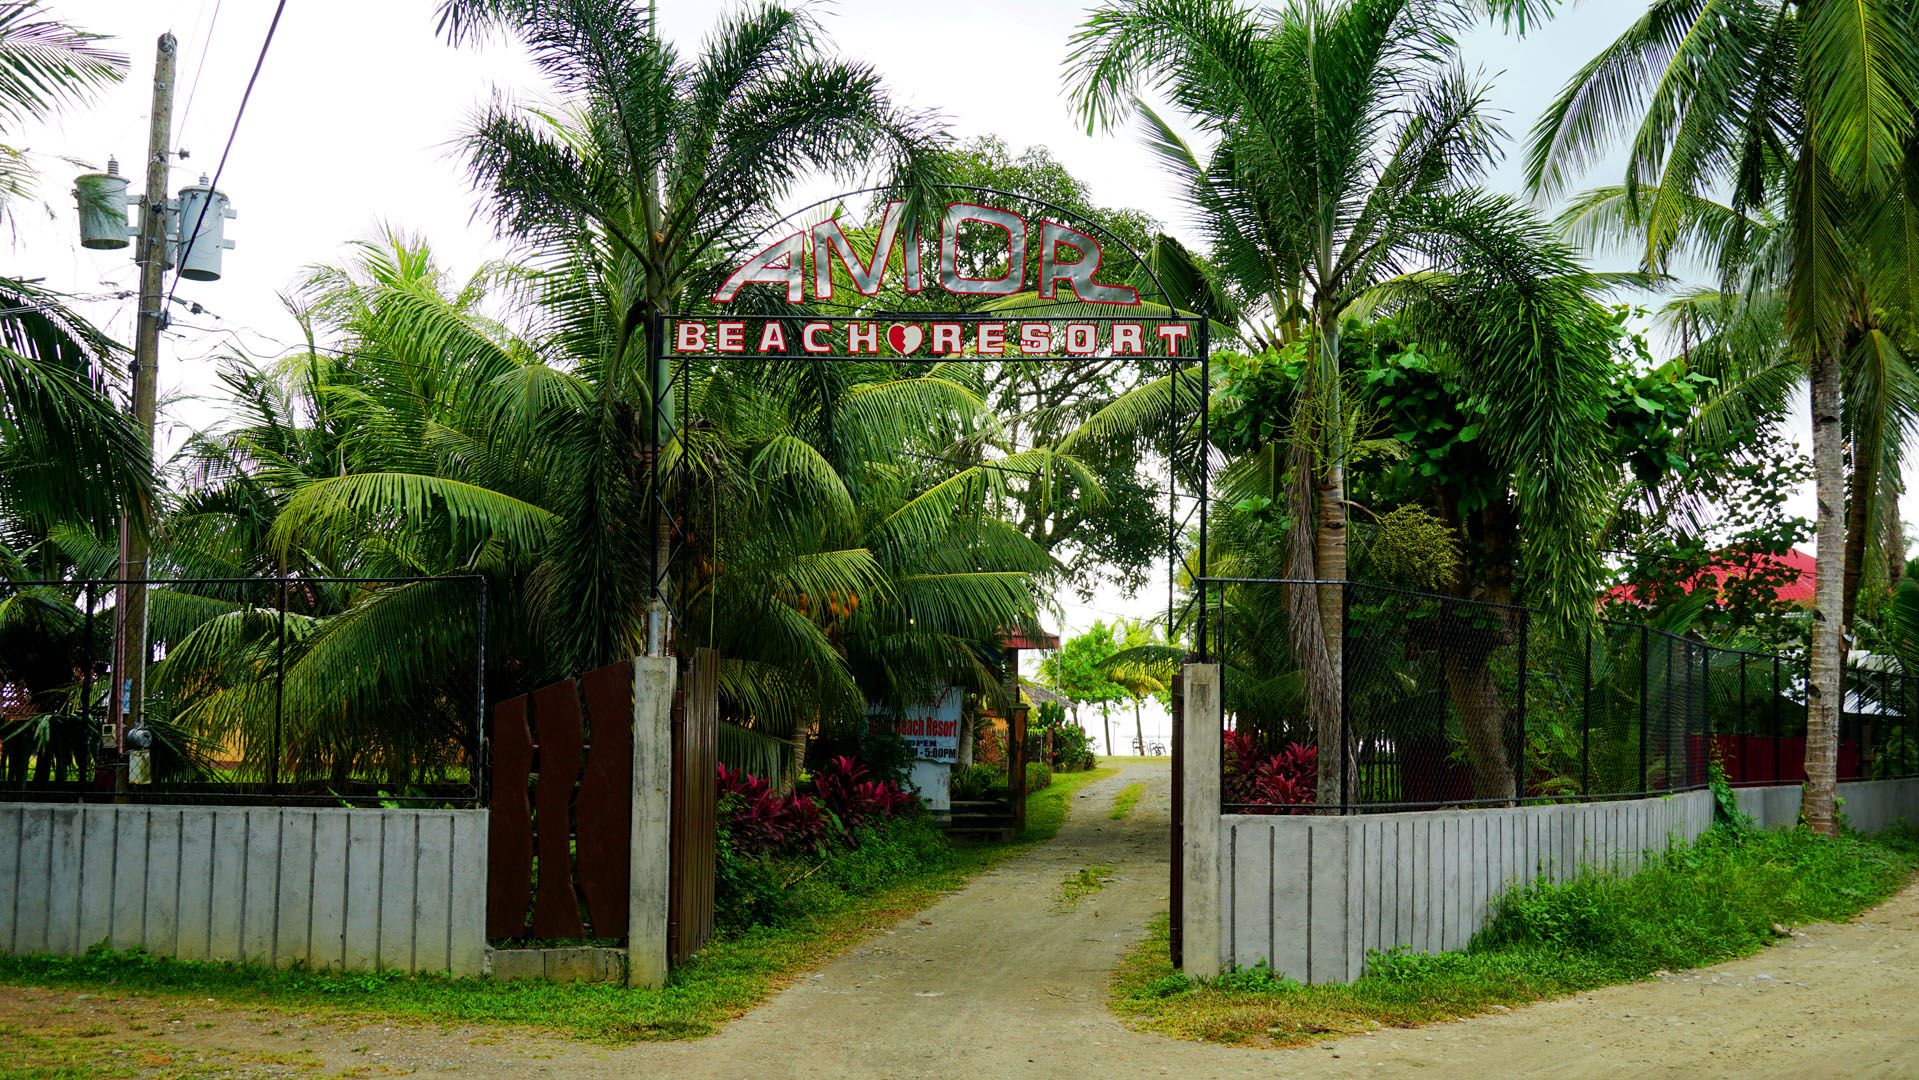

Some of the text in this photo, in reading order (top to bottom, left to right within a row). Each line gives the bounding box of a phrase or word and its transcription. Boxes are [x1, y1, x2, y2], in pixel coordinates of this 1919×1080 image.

[711, 200, 1142, 305] AMOR
[676, 321, 1188, 355] BEACH RESORT
[926, 717, 957, 737] Resort
[925, 748, 956, 758] 5:00PM
